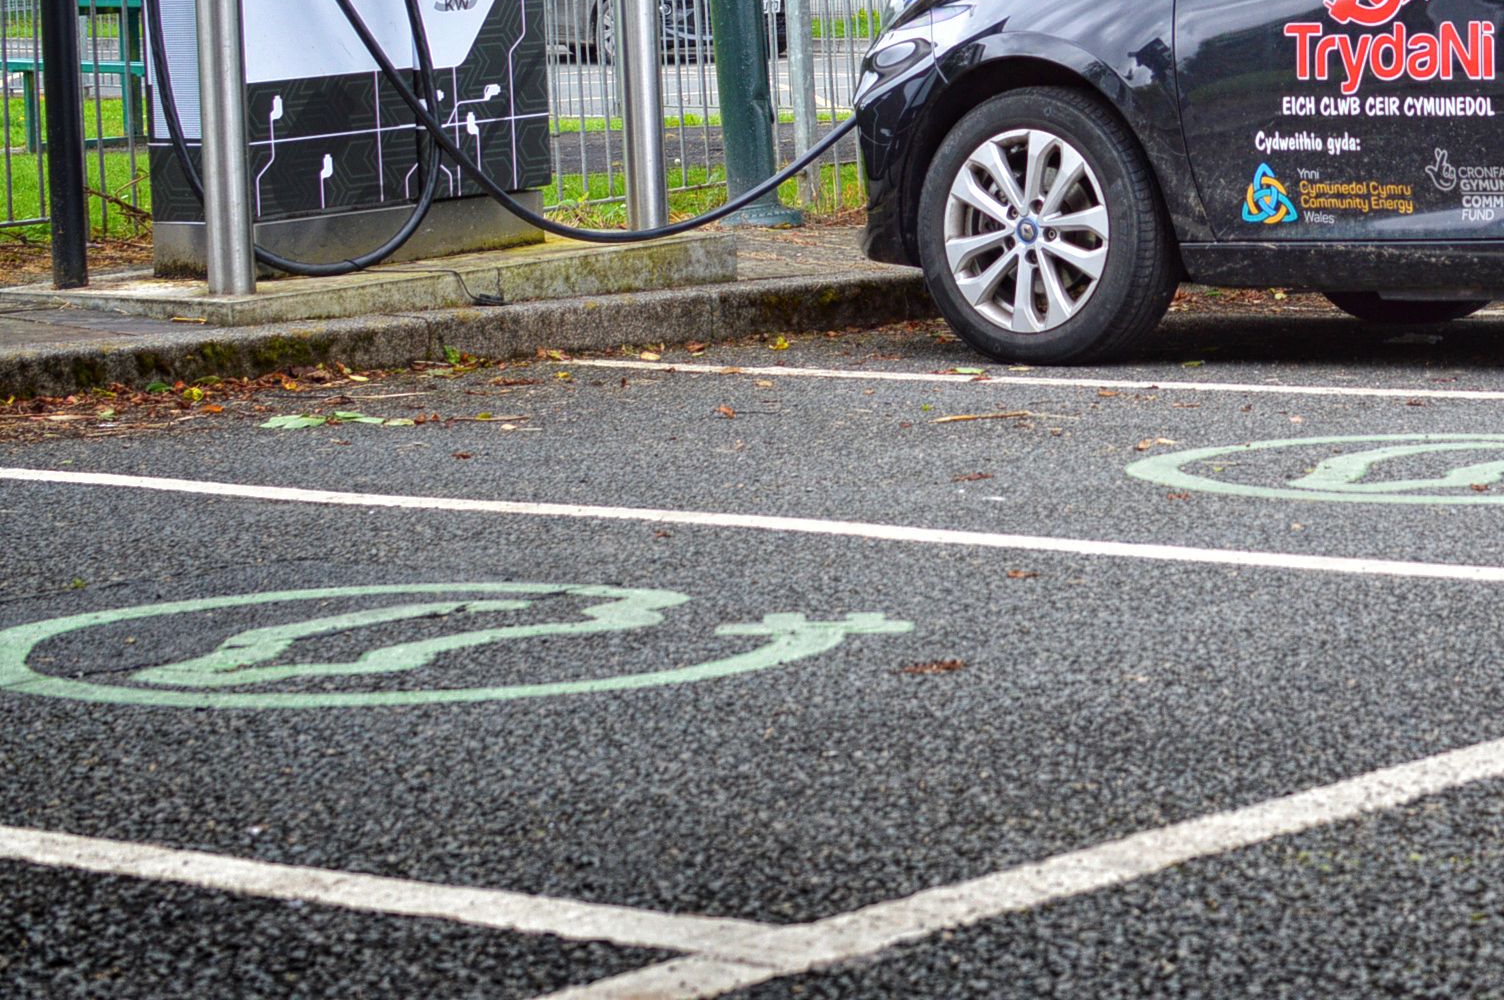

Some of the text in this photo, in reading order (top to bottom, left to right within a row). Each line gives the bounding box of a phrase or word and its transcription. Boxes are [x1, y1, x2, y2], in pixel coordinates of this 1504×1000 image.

[1283, 21, 1495, 95] TrydaNi
[1282, 96, 1495, 116] EICH CLWB CEIR CYMUNEDOL
[1255, 131, 1361, 155] Cydweithio gyda:
[1297, 167, 1319, 180] Ynni
[1300, 180, 1411, 198] Cymunedol Cymru
[1301, 197, 1413, 214] Community Energy
[1304, 211, 1335, 224] Wales
[1462, 209, 1495, 221] FUND
